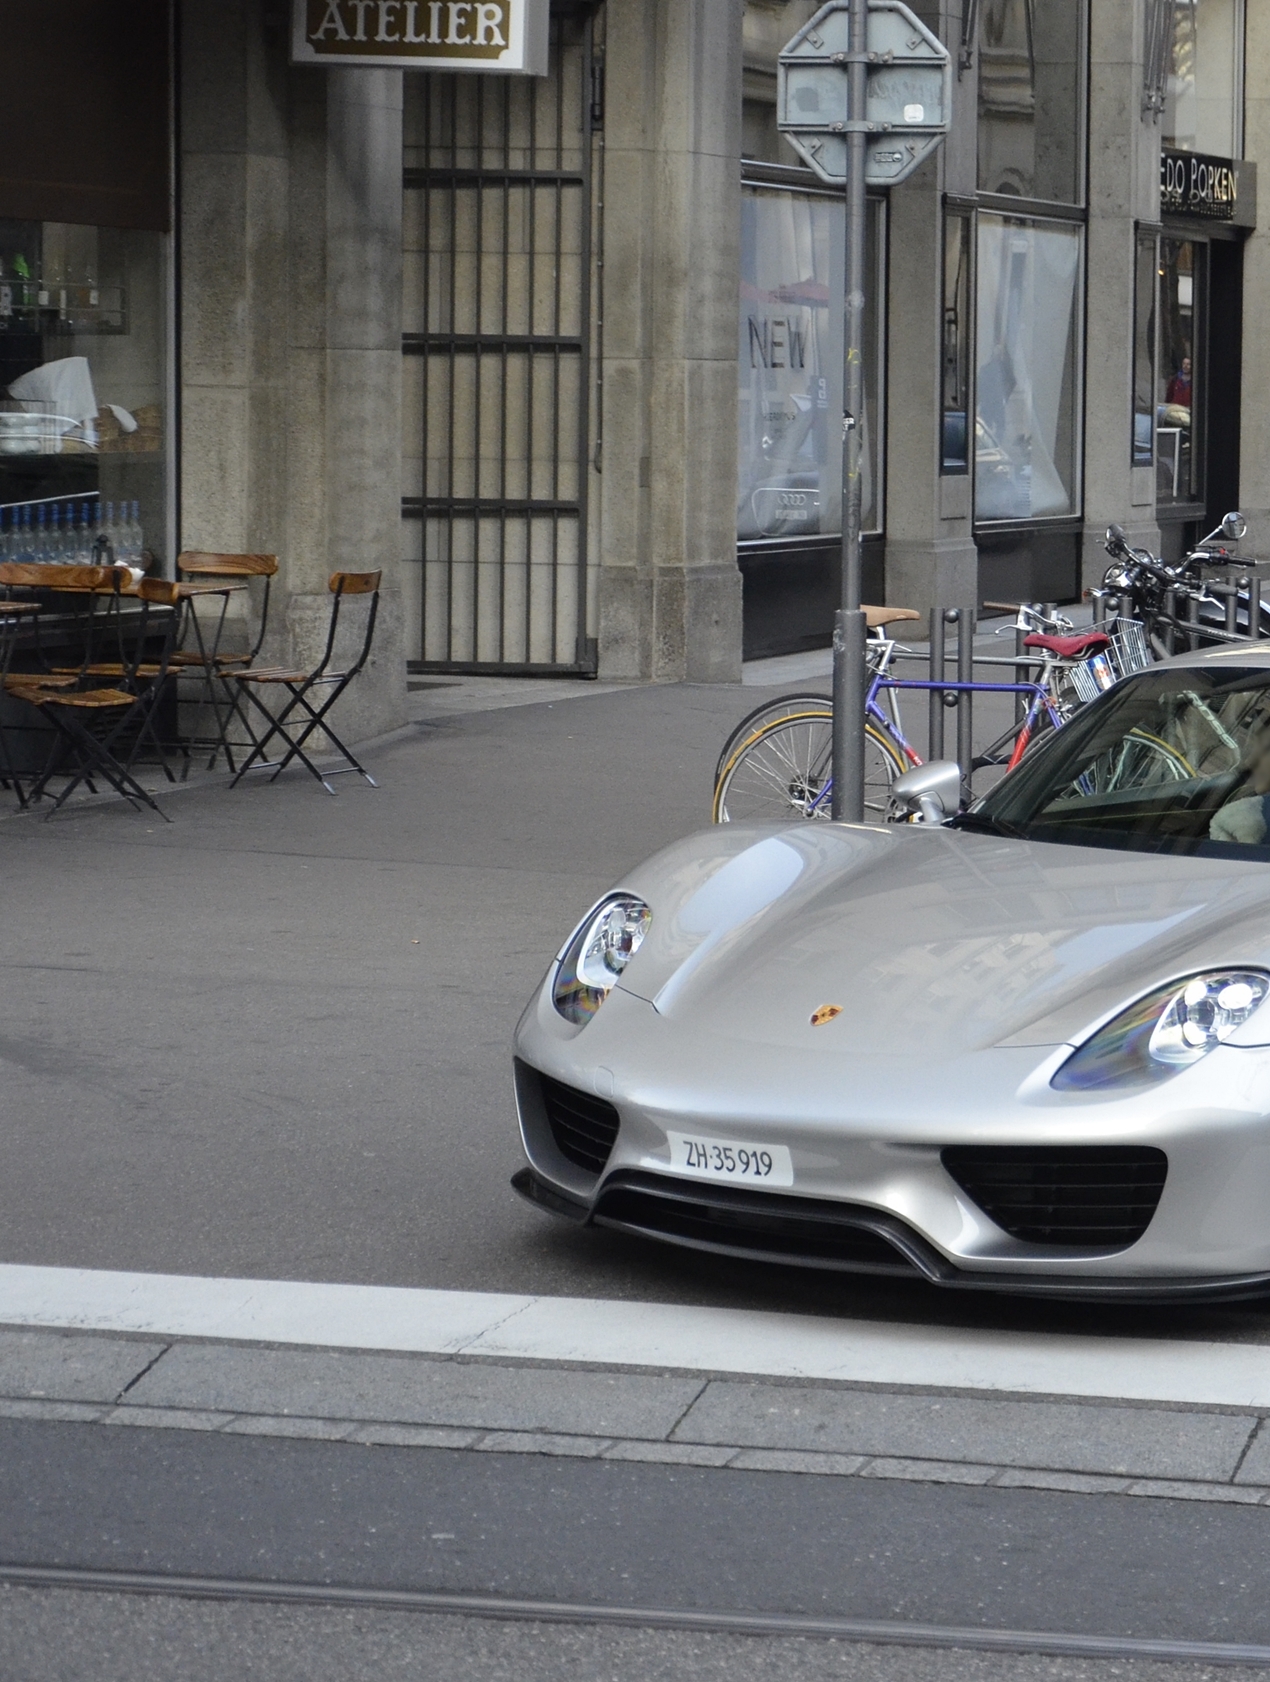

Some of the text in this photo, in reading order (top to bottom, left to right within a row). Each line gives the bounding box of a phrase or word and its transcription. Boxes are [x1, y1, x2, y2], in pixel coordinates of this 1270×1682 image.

[309, 0, 506, 46] ATELIER
[1191, 158, 1237, 201] POPKEN
[747, 317, 808, 369] NEW
